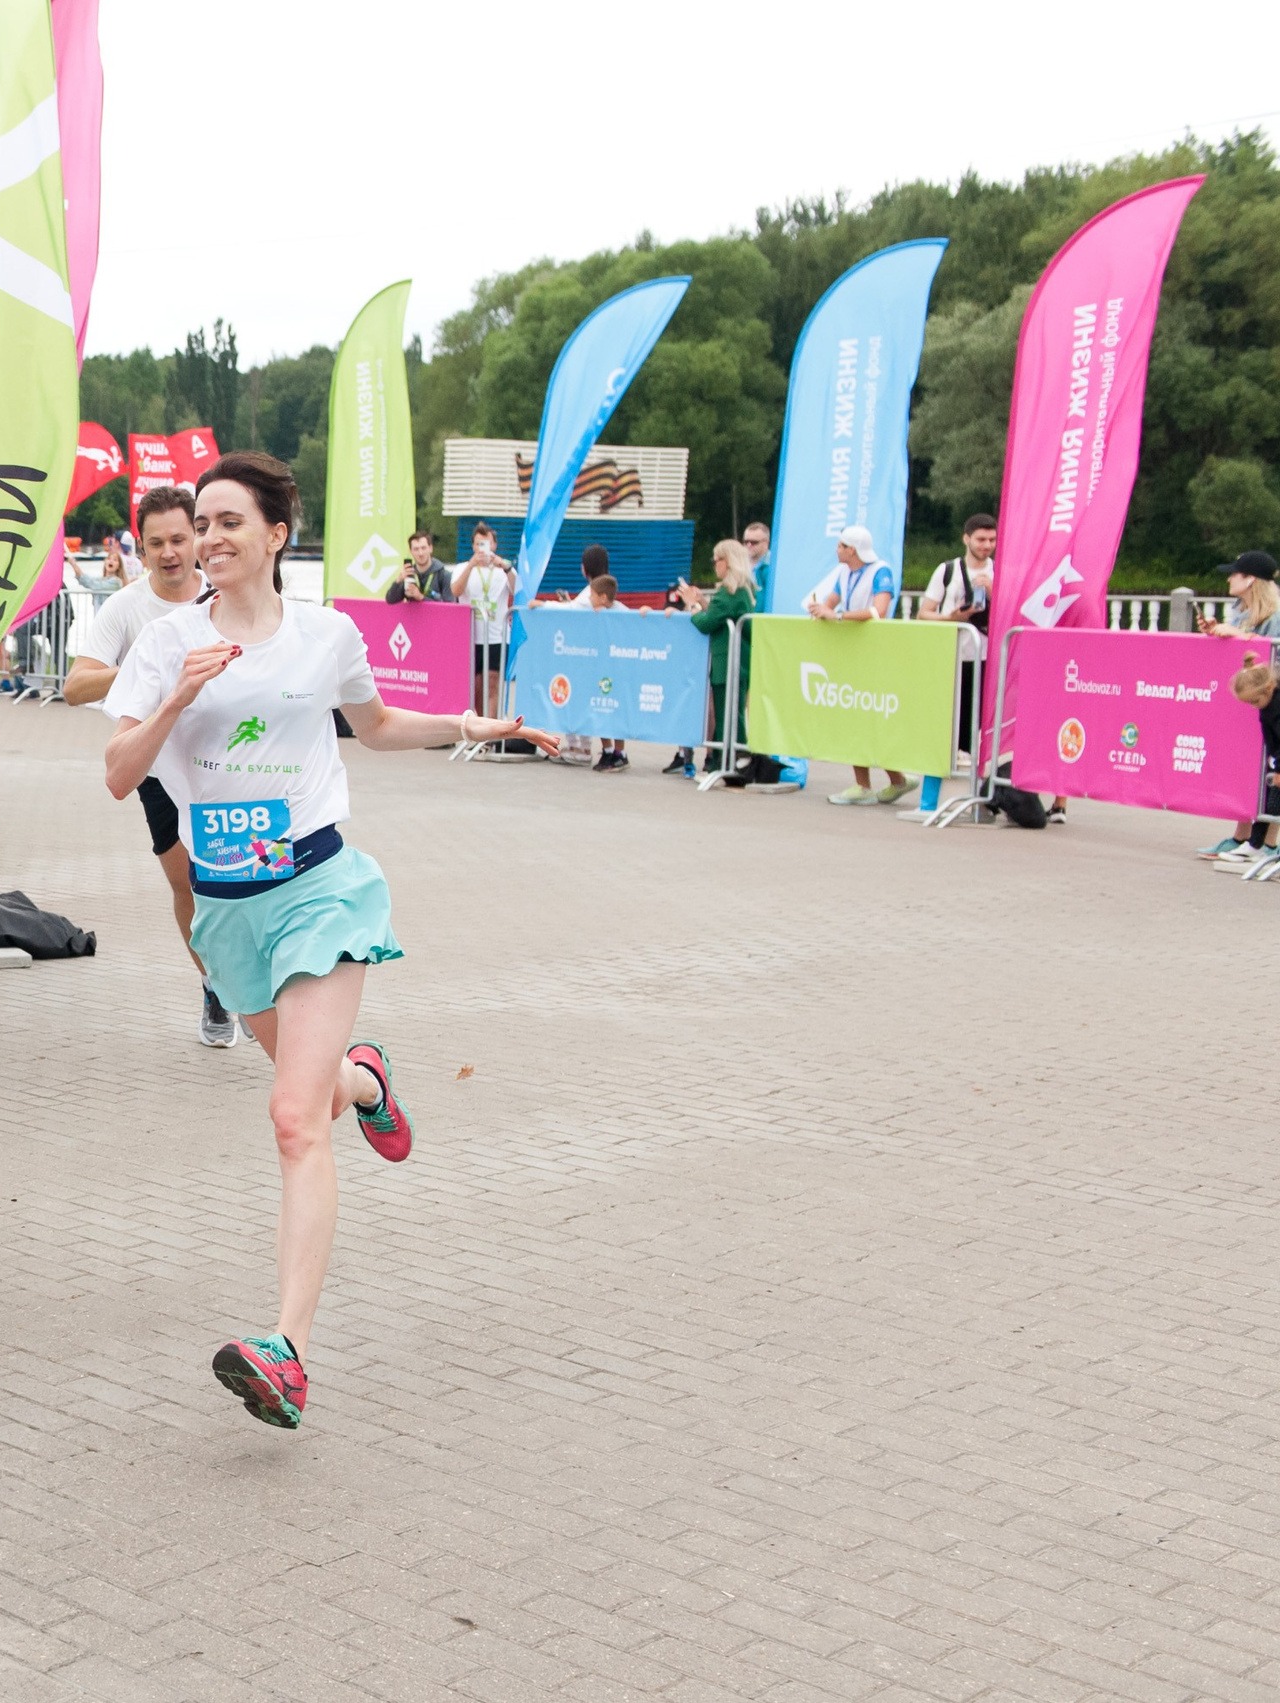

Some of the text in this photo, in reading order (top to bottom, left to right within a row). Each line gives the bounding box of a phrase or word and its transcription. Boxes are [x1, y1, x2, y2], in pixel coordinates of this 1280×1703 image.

[1100, 297, 1124, 348] фонд
[1049, 302, 1098, 533] ЛИНИЯ ЖИЗНИ
[355, 360, 374, 517] ЛИНИЯ ЖИЗНИ
[825, 337, 859, 538] ЛИНИЯ ЖИЗНИ
[1077, 680, 1121, 696] Vodovoz.ru
[1136, 680, 1211, 703] Белая Дача
[813, 680, 899, 720] X5Group
[1176, 734, 1205, 749] СОЮЗ
[193, 756, 303, 774] ЗАБЕГ ЗА БУДУЩЕ
[1108, 750, 1147, 766] СТЕПЬ
[1173, 747, 1207, 762] МУЛЬТ
[1173, 760, 1203, 774] ПАРК
[202, 806, 271, 834] 3198
